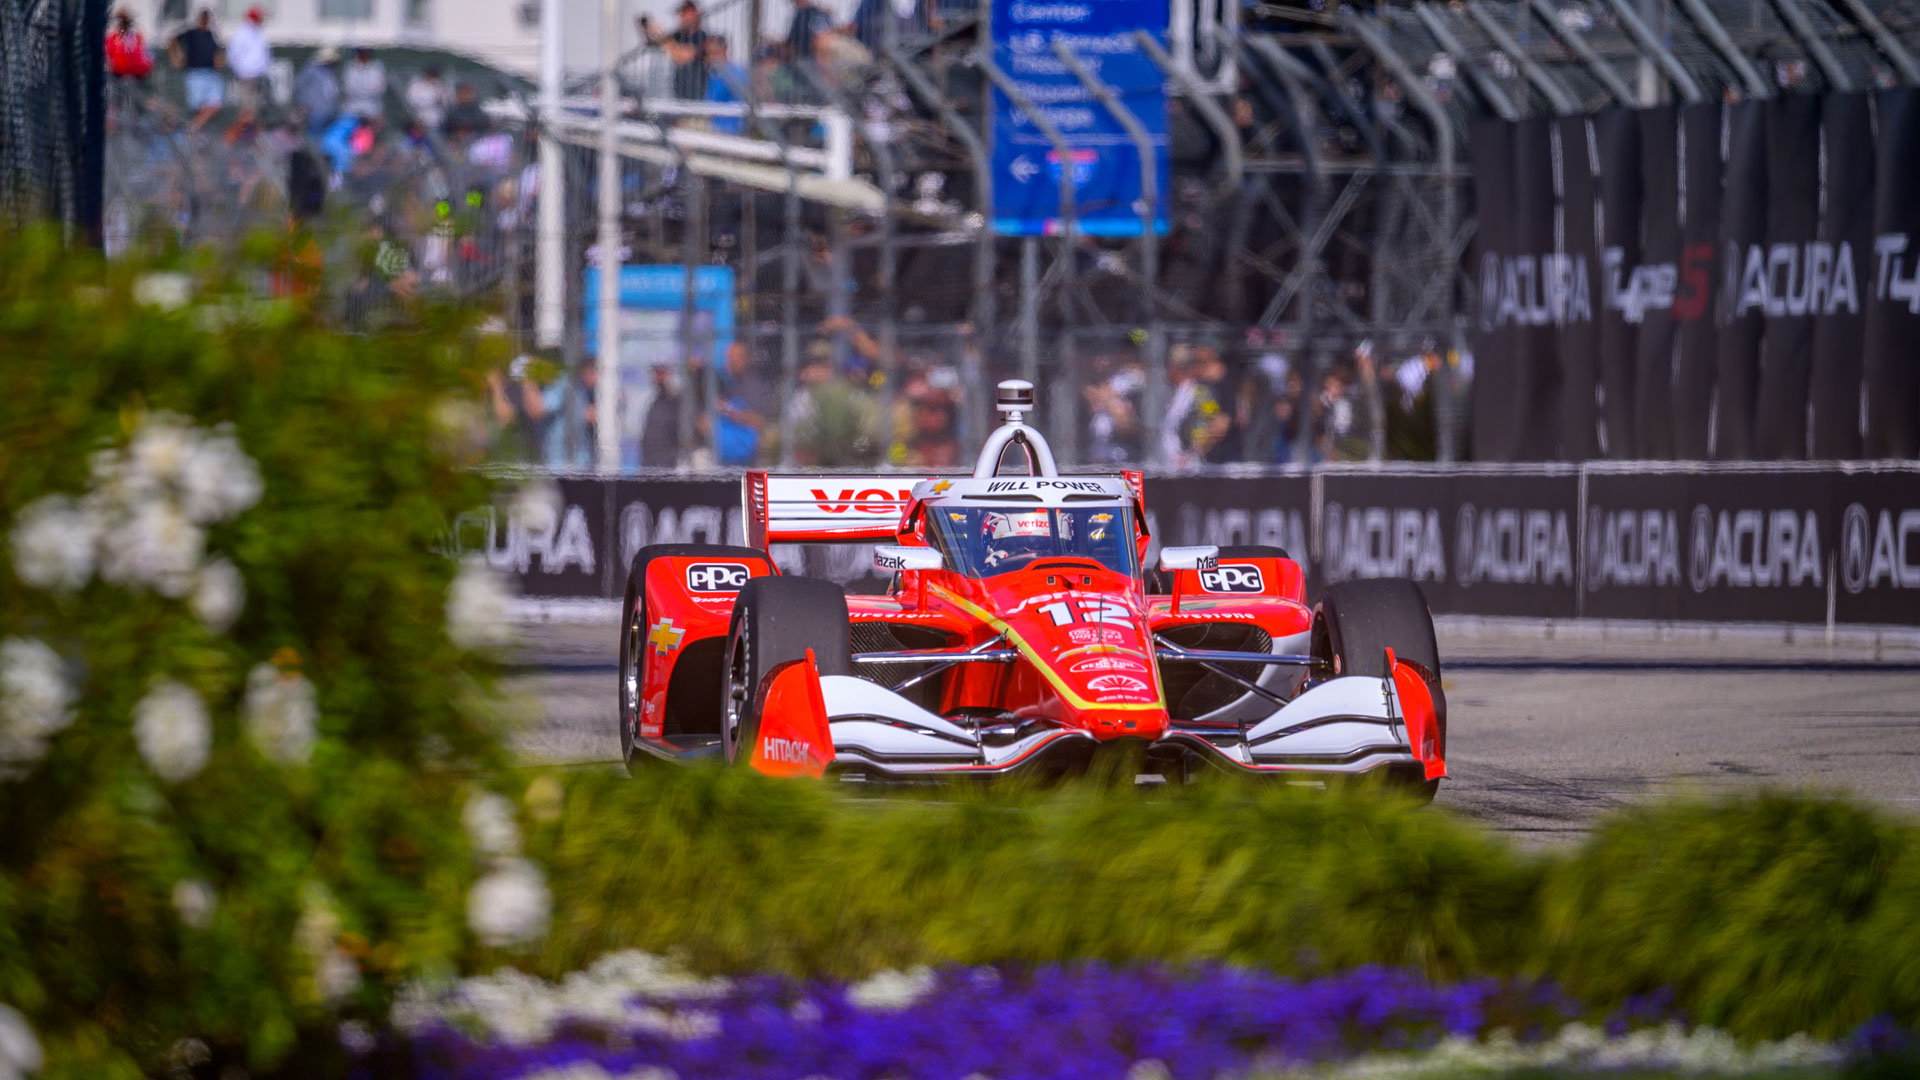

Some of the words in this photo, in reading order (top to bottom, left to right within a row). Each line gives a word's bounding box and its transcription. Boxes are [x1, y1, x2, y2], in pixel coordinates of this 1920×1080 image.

[1499, 254, 1593, 325] ACURA
[1736, 241, 1860, 318] ACURA
[987, 481, 1031, 493] WILL
[1036, 481, 1106, 494] POWER
[432, 504, 596, 576] CURA
[1017, 519, 1050, 528] verizo
[1342, 507, 1446, 582] ACURA
[1472, 508, 1572, 586] ACURA
[1602, 510, 1681, 587] ACURA
[1709, 509, 1822, 588] ACURA
[691, 566, 747, 590] PPG
[1203, 568, 1261, 591] PPG
[1037, 601, 1137, 631] 12
